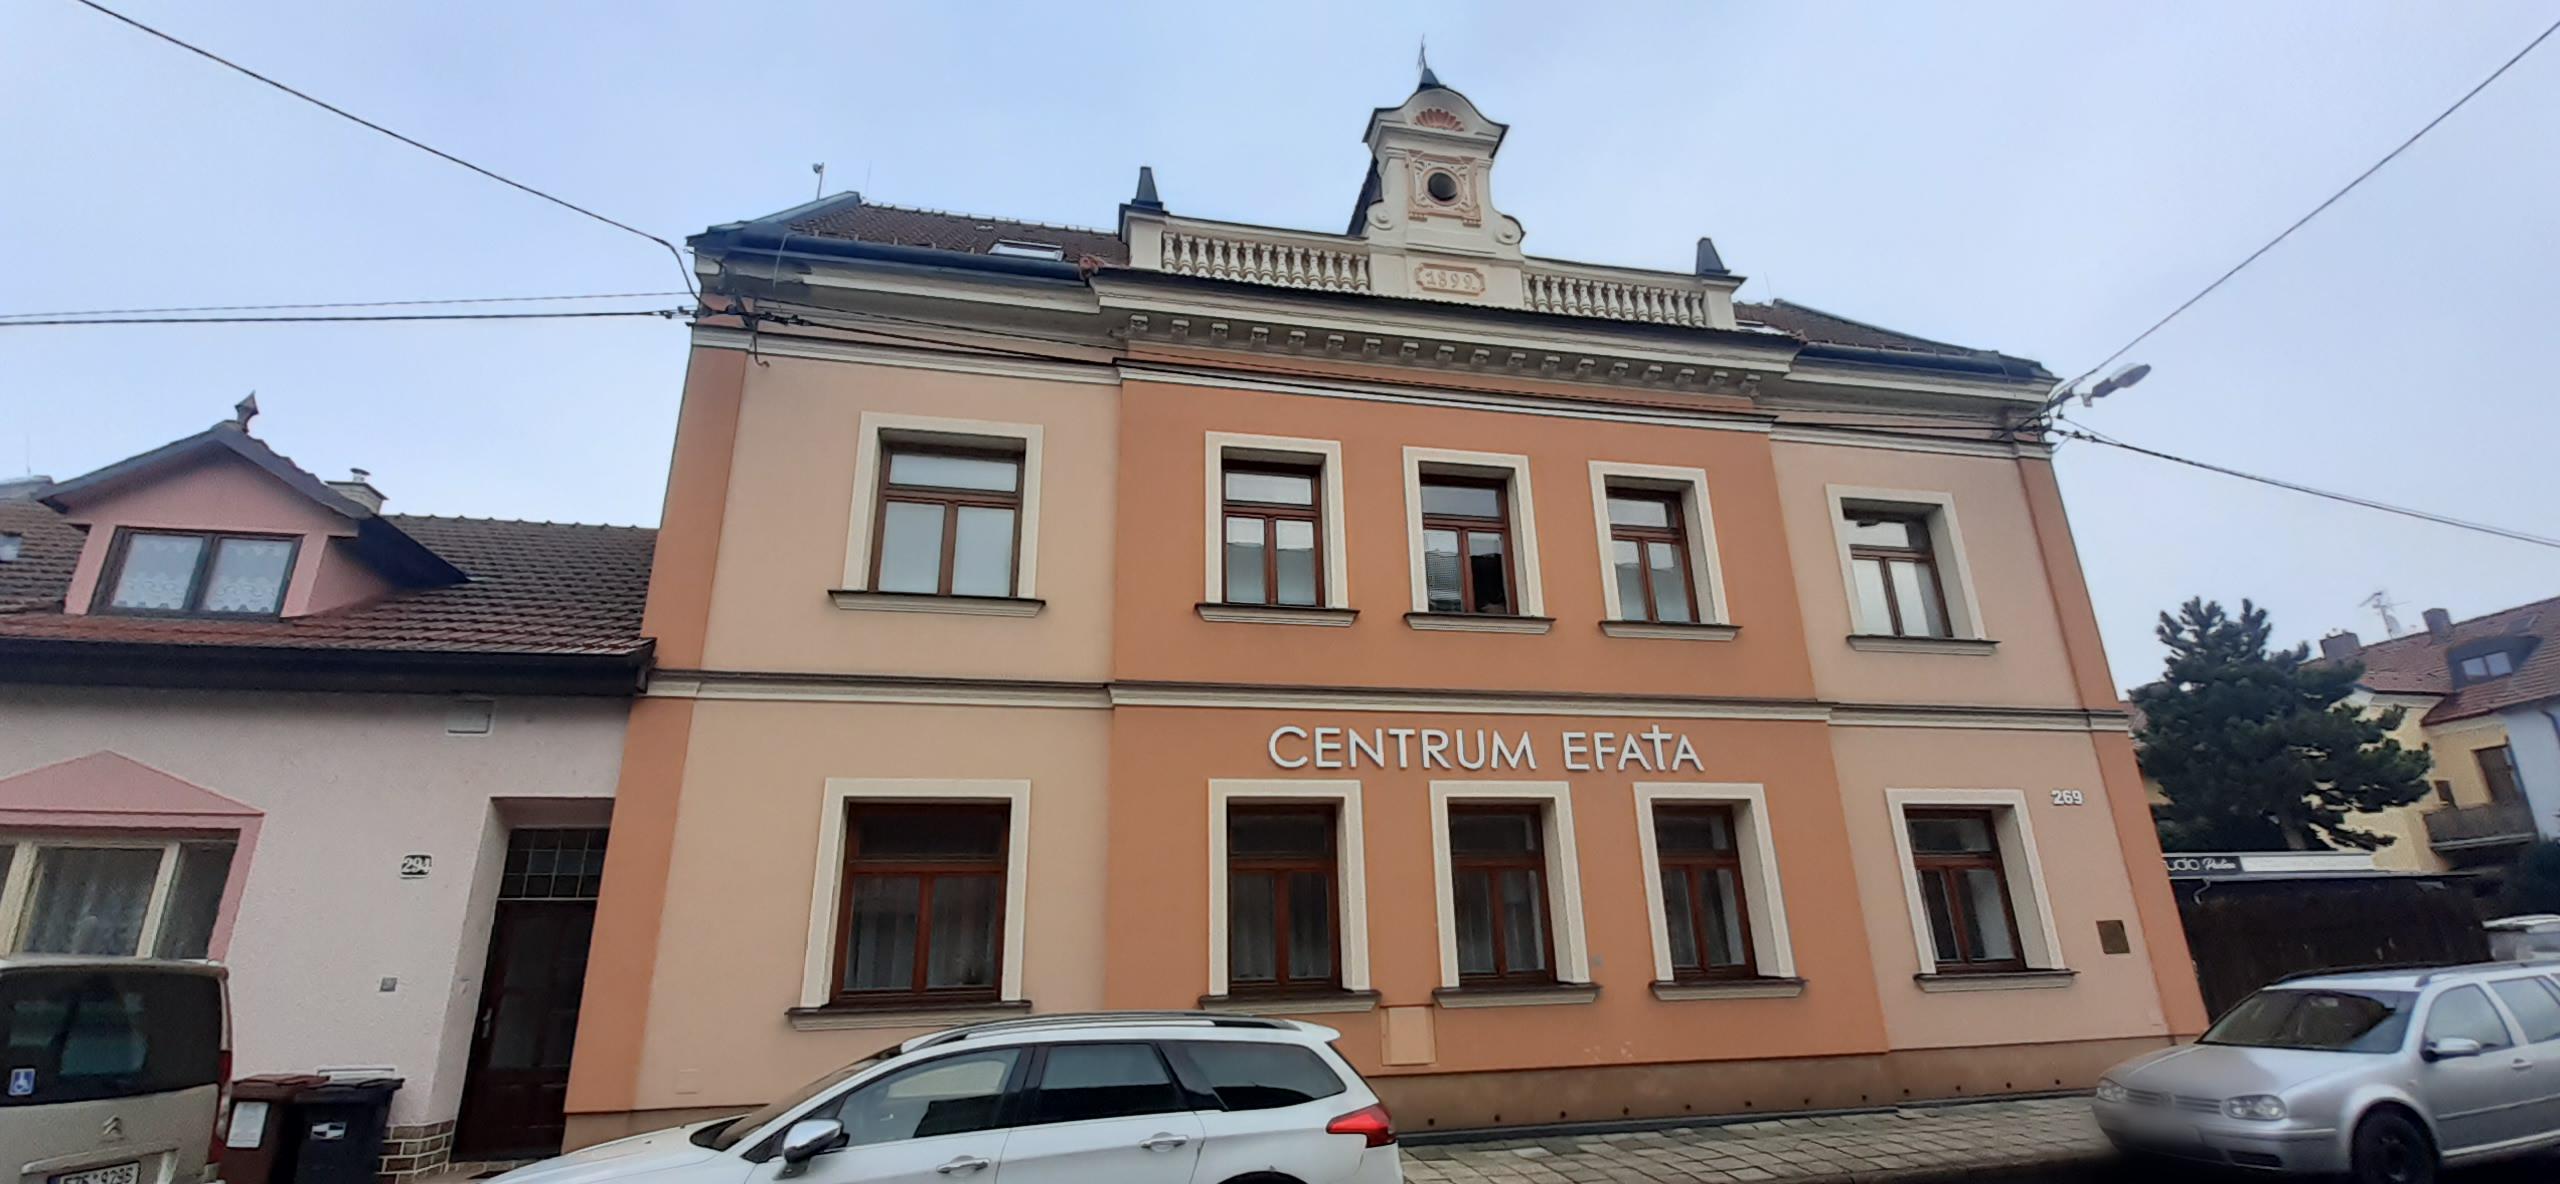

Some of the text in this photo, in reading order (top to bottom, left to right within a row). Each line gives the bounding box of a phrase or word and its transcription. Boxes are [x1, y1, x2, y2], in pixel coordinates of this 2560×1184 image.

[1268, 724, 1705, 771] CENTRUM EFATA
[2051, 789, 2083, 805] 269
[400, 857, 431, 873] 294
